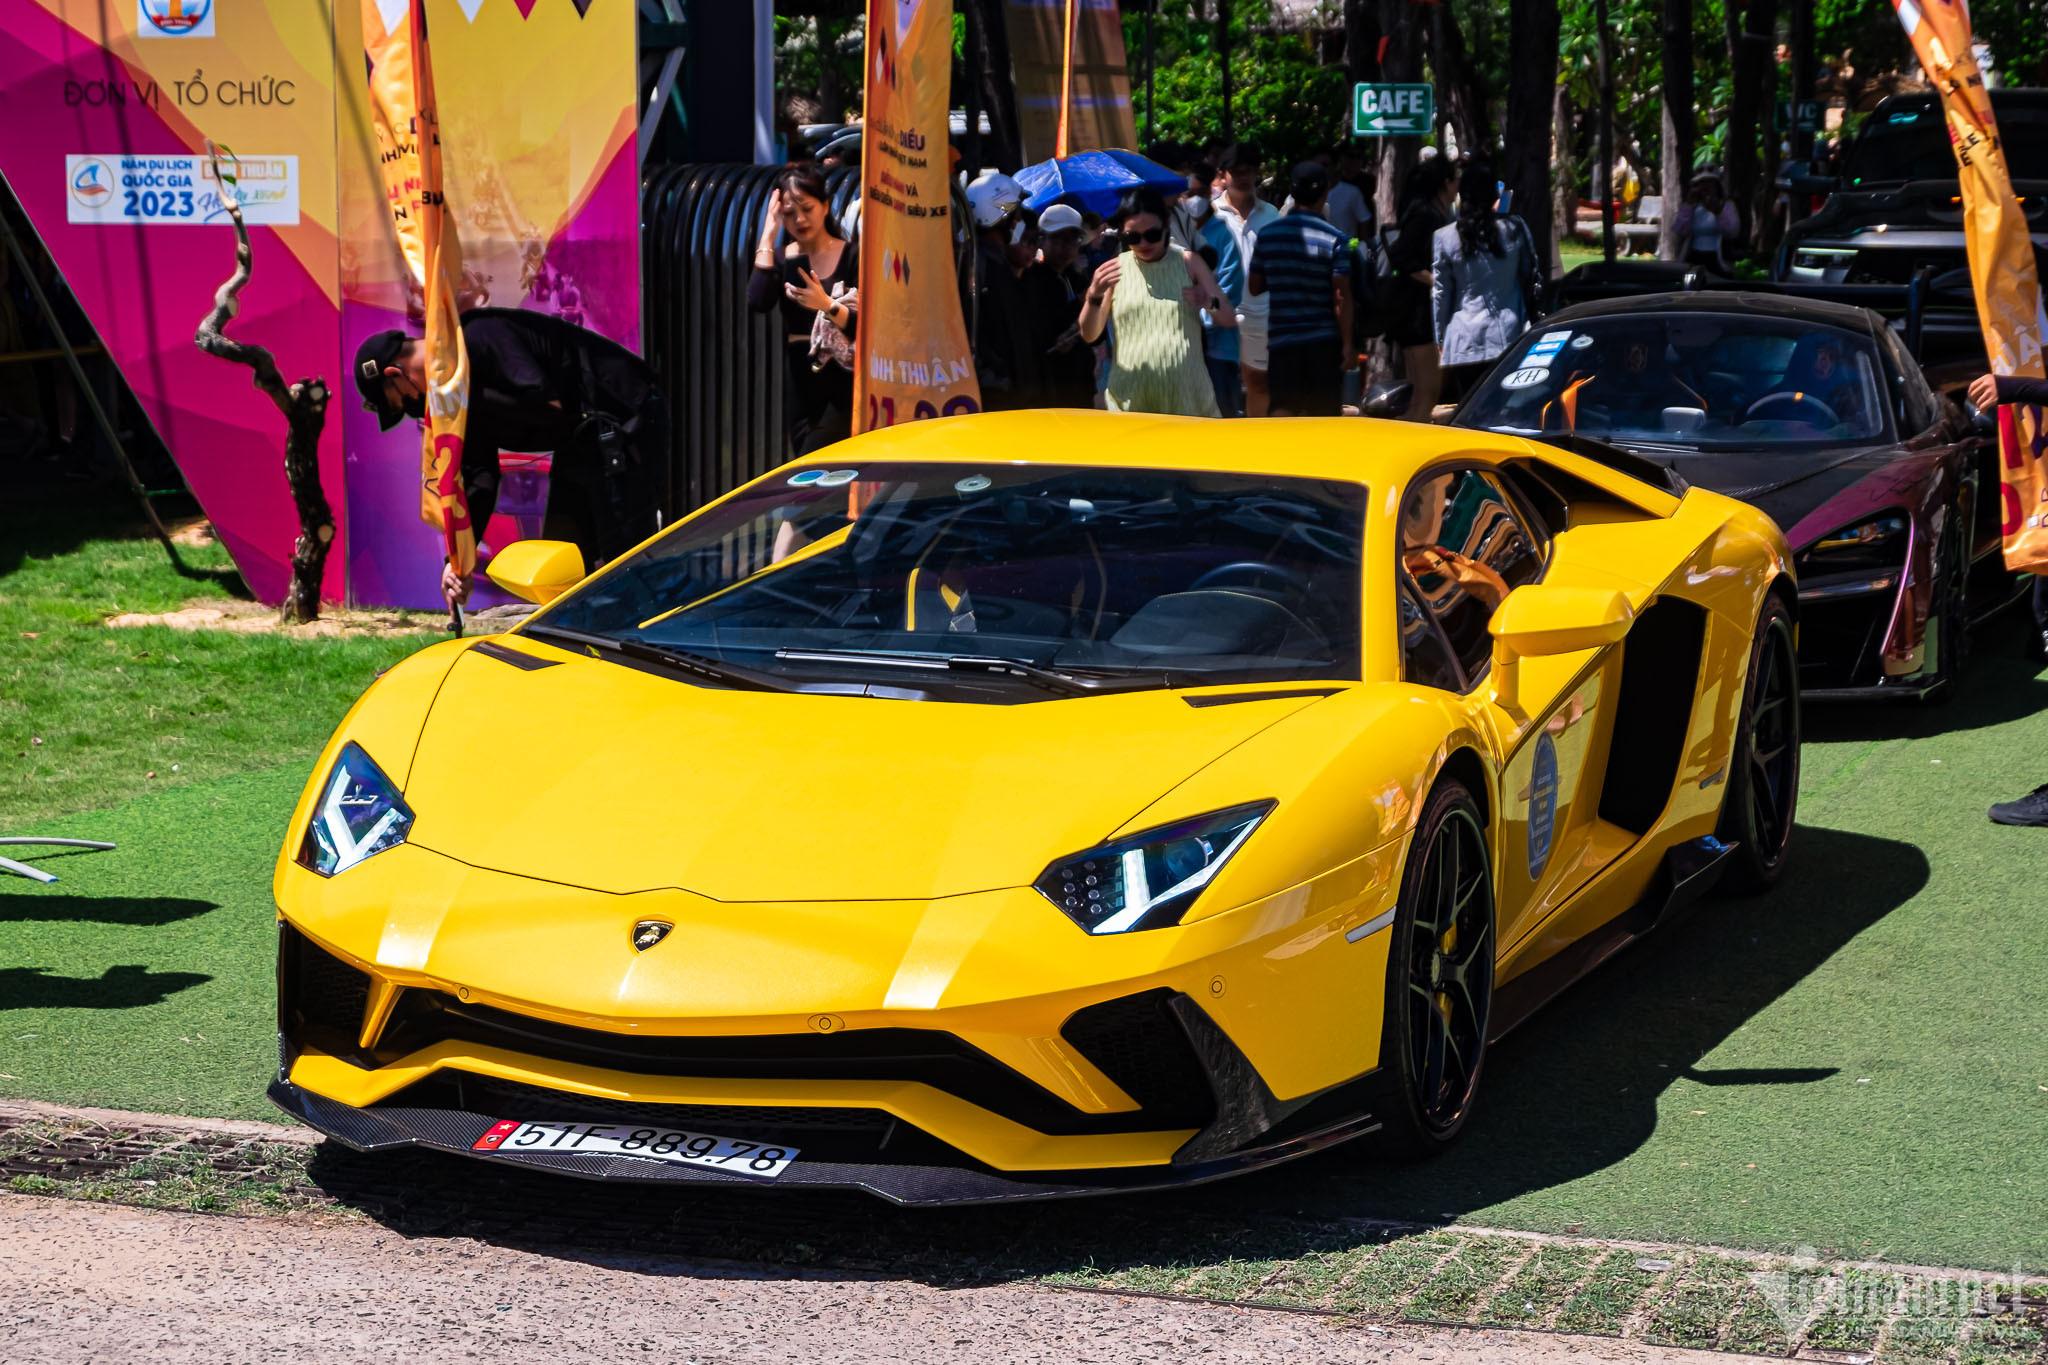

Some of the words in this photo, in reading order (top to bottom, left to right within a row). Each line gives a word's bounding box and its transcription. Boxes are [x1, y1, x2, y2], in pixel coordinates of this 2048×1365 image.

[64, 79, 126, 106] ĐƠN
[134, 80, 159, 111] VỊ
[174, 68, 209, 106] TỔ
[216, 75, 296, 106] CHỨC
[1361, 89, 1424, 114] CAFE
[167, 174, 193, 188] GIA
[124, 190, 195, 217] 2023
[929, 205, 947, 217] XE
[898, 356, 970, 393] THUẬN
[1511, 370, 1542, 385] KH
[513, 1122, 788, 1173] 51F-889.78
